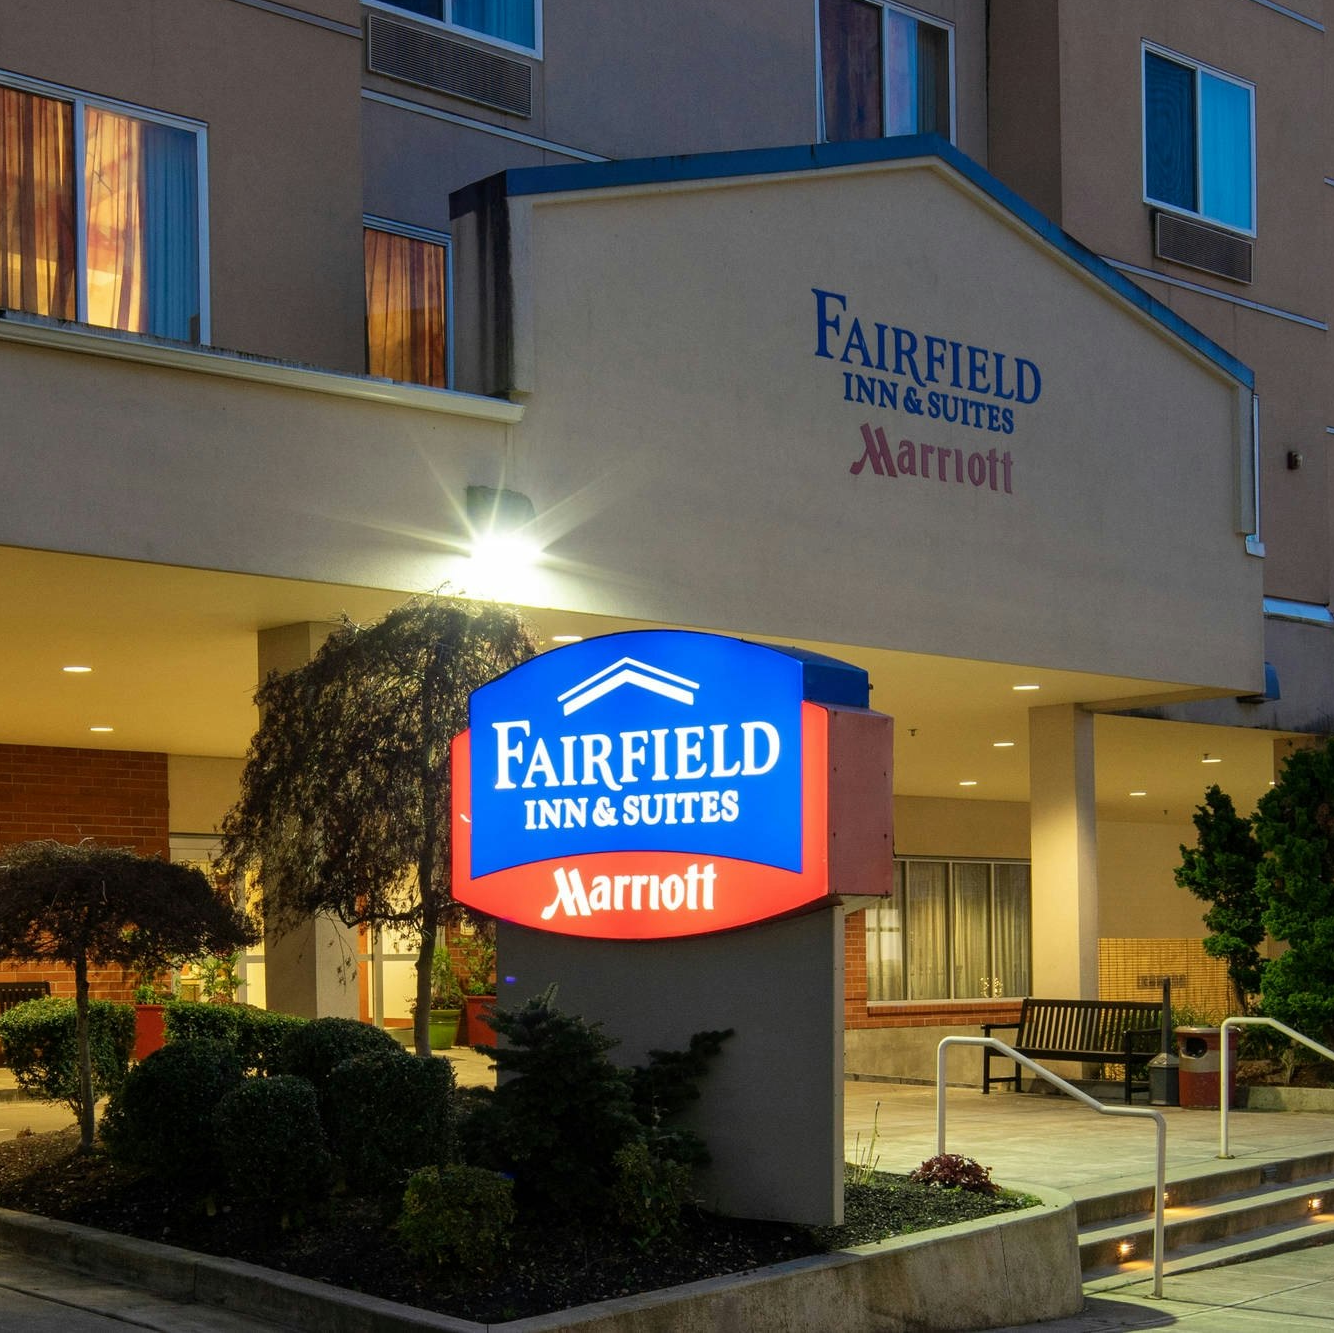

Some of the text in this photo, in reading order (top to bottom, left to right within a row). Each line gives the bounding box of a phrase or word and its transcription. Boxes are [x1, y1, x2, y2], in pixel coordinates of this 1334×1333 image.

[811, 287, 1042, 405] FAIRFIELD
[842, 371, 1015, 435] INN & SUITES
[849, 422, 1014, 495] Marriott
[492, 719, 781, 792] FAIRFIELD
[524, 789, 740, 831] INN & SUITES
[541, 862, 717, 921] Marriott
